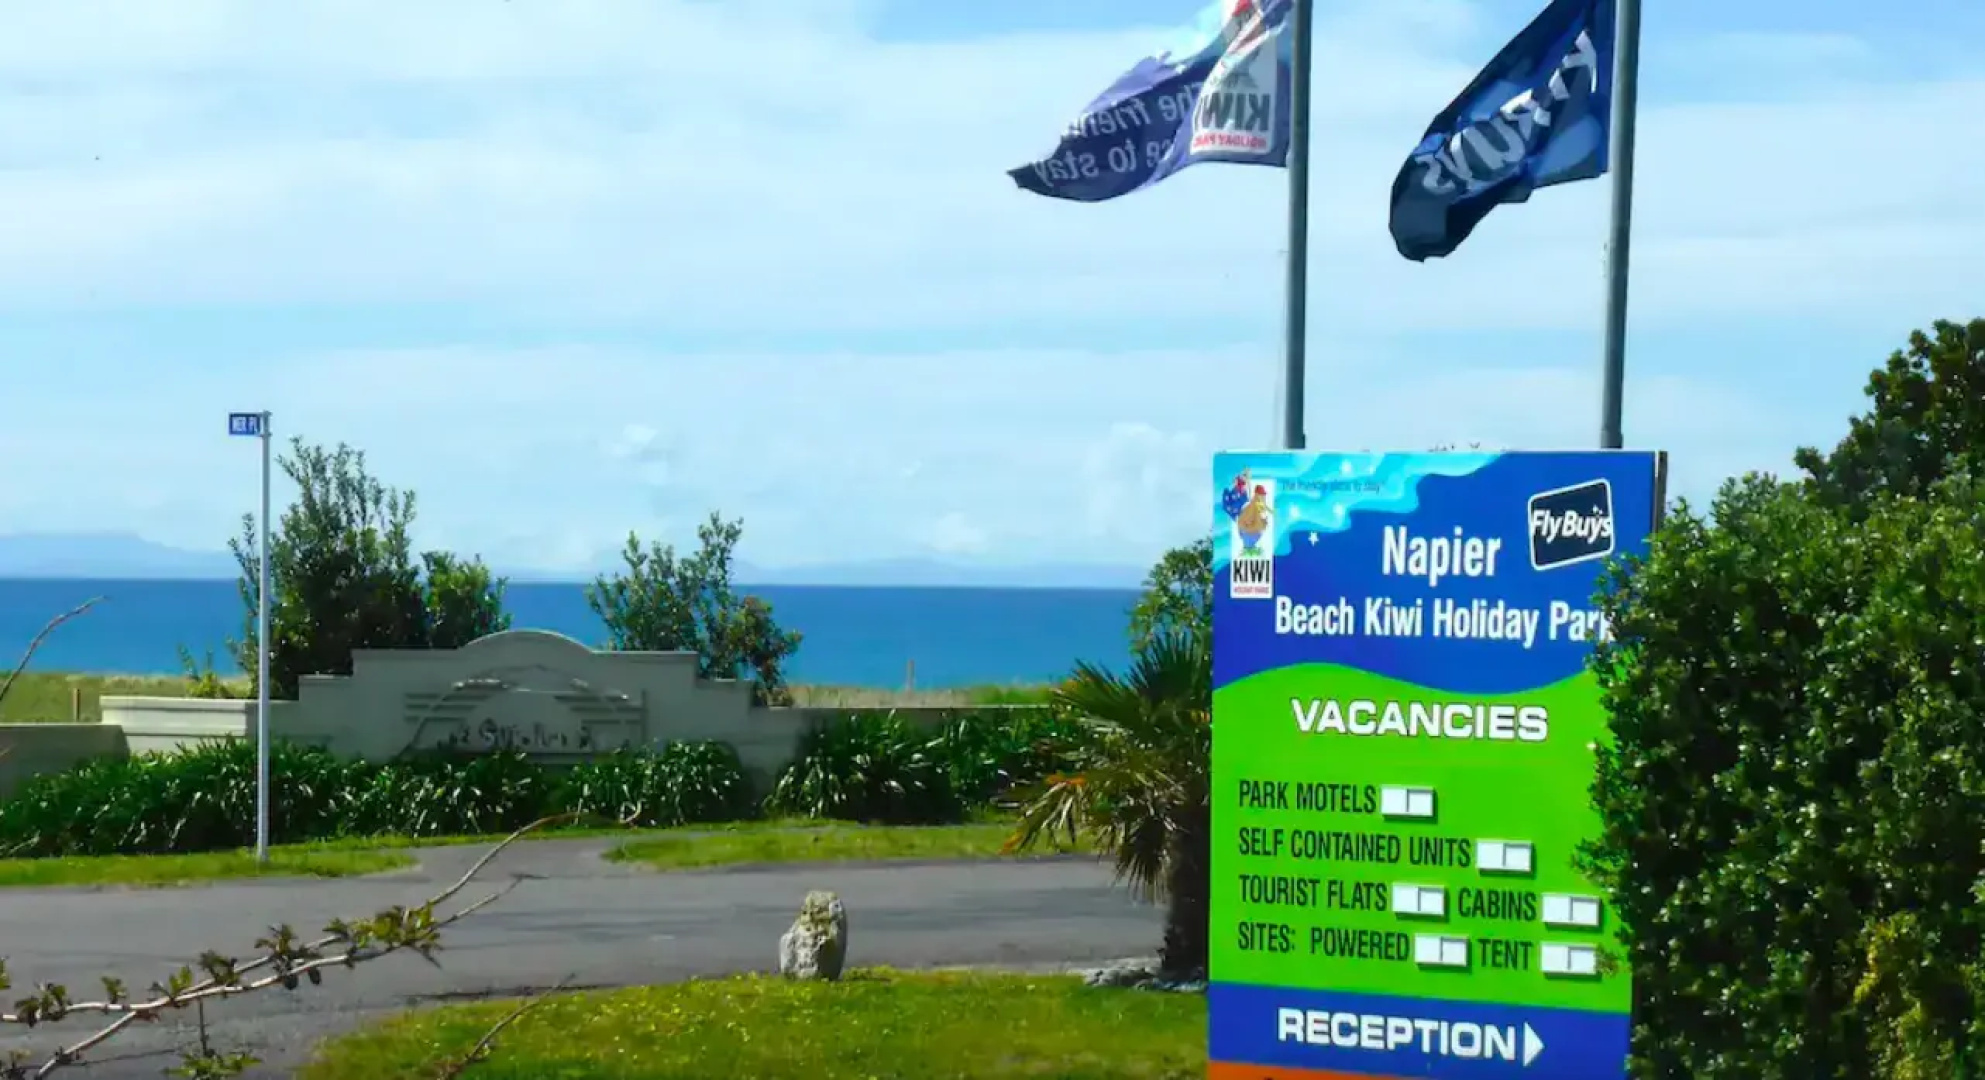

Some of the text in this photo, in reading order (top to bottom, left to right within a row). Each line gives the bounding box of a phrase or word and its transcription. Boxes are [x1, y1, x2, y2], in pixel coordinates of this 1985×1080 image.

[1232, 558, 1270, 584] KIWI
[1382, 526, 1501, 587] Napier
[1276, 596, 1354, 636] Beach
[1365, 599, 1422, 637] Kiwi
[1434, 602, 1538, 649] Holiday
[1291, 698, 1549, 742] VACANCIES
[1239, 780, 1377, 814] PARK MOTELS
[1239, 828, 1471, 869] SELF CONTAINED UNITS
[1239, 875, 1536, 922] TOURIST FLATS CABINS
[1238, 922, 1533, 970] SITES: POWERED TENT
[1278, 1007, 1515, 1062] RECEPTION
